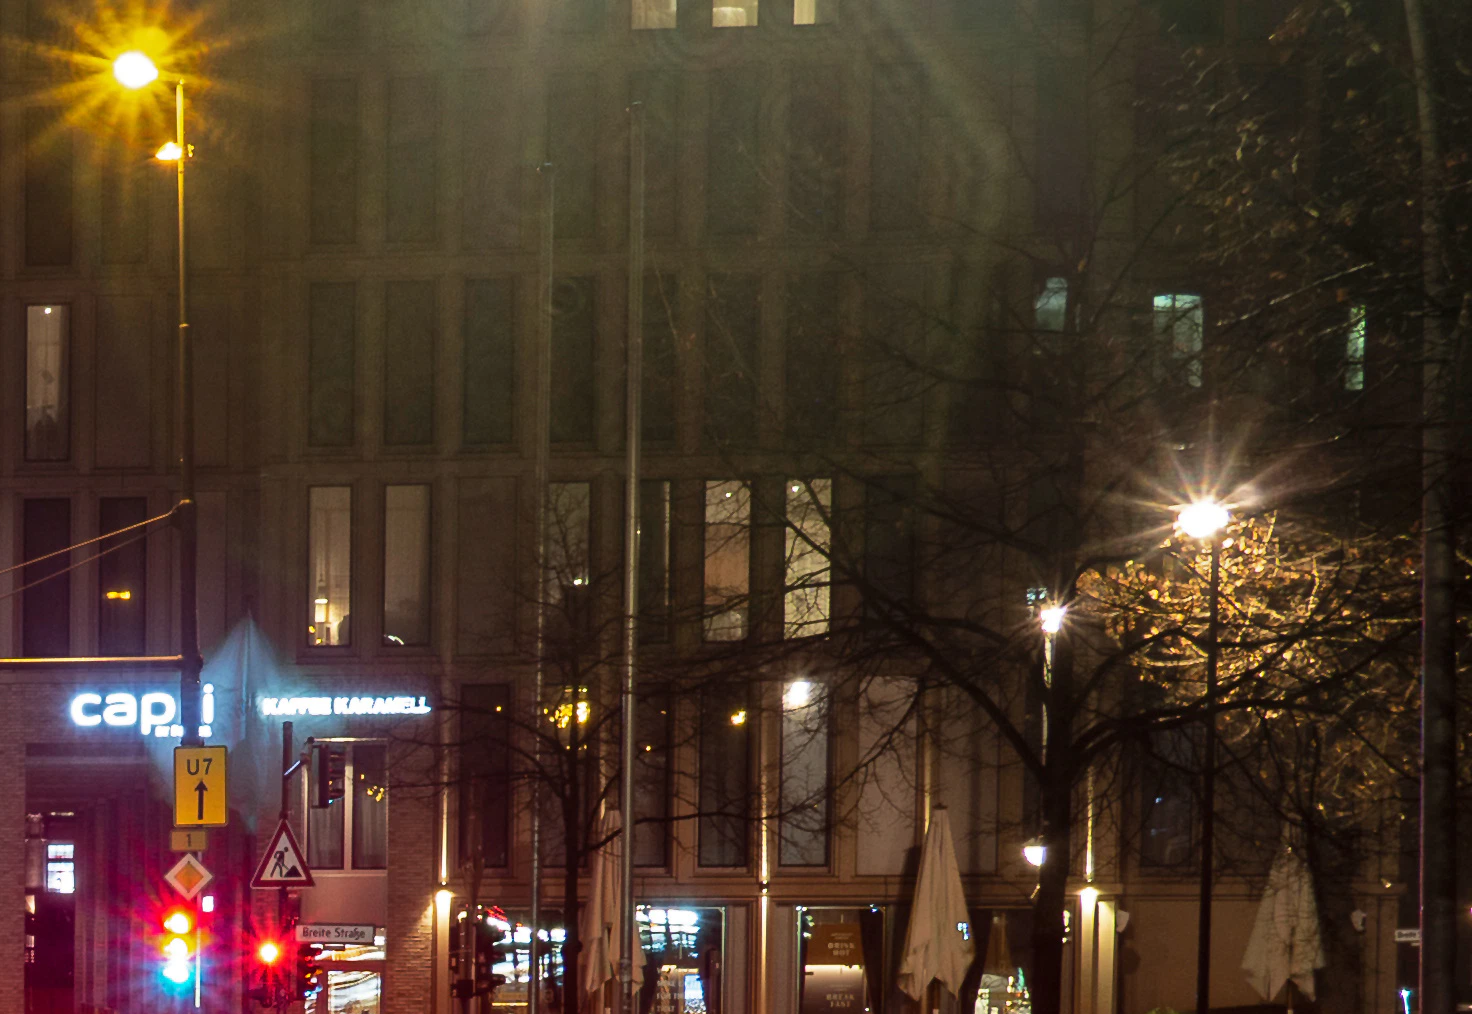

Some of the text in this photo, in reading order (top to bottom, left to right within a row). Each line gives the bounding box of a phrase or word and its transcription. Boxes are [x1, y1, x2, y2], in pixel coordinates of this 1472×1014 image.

[70, 683, 215, 736] capi
[187, 758, 212, 775] U7
[303, 926, 366, 941] Breite Straße
